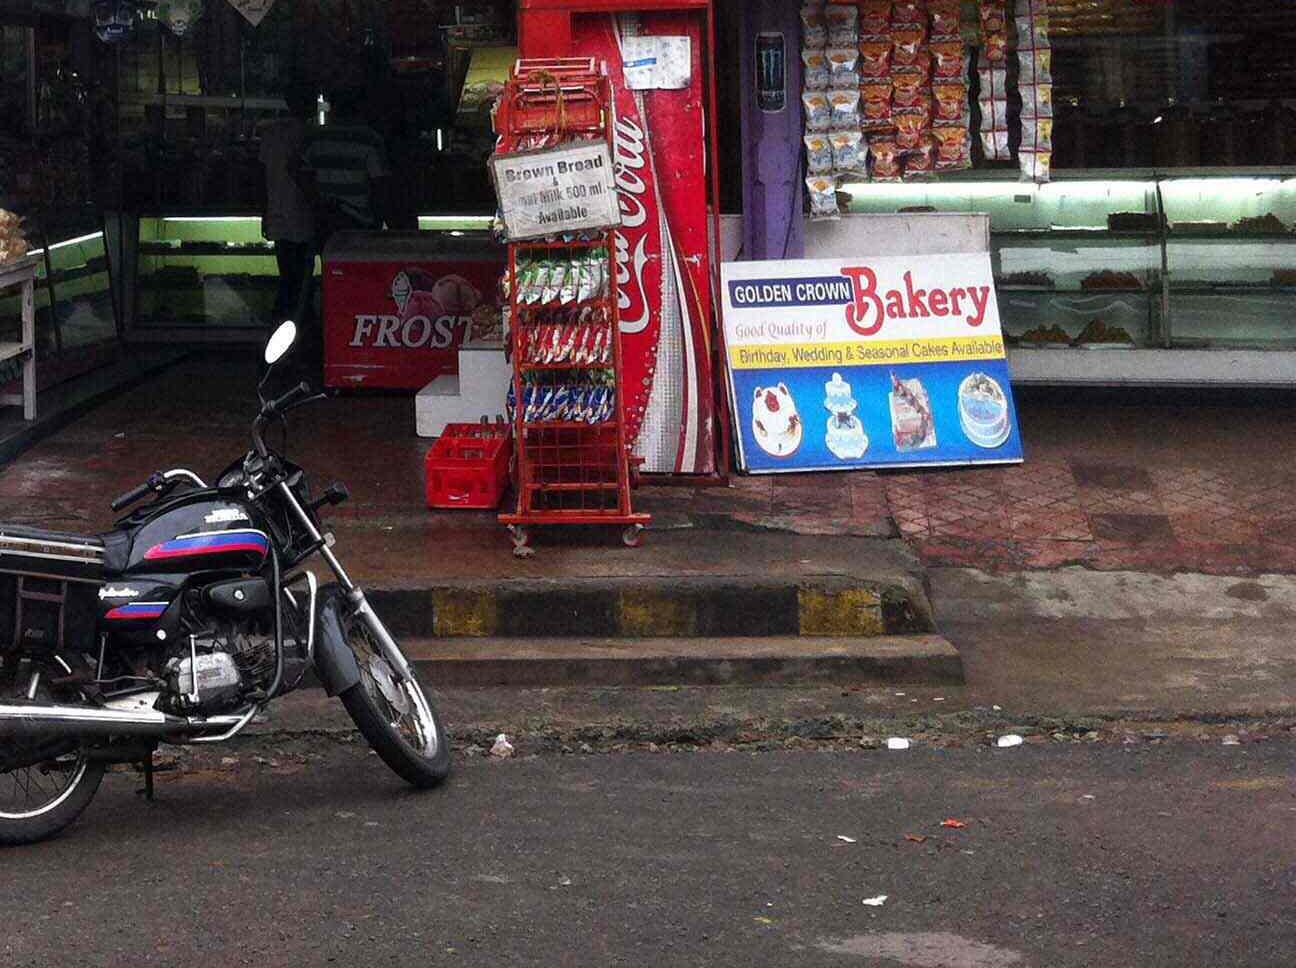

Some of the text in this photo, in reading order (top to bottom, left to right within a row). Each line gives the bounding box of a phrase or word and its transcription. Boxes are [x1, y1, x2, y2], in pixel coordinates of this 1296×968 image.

[505, 154, 603, 183] Brown Bread
[538, 206, 589, 224] Available
[735, 282, 851, 304] GOLDEN CROWN
[840, 267, 990, 336] Bakery
[735, 319, 828, 339] Good Quality of
[739, 347, 791, 365] Birthday,
[791, 346, 843, 364] Wedding
[846, 346, 854, 360] &
[856, 343, 910, 361] Seasonal
[911, 342, 949, 357] Cakes
